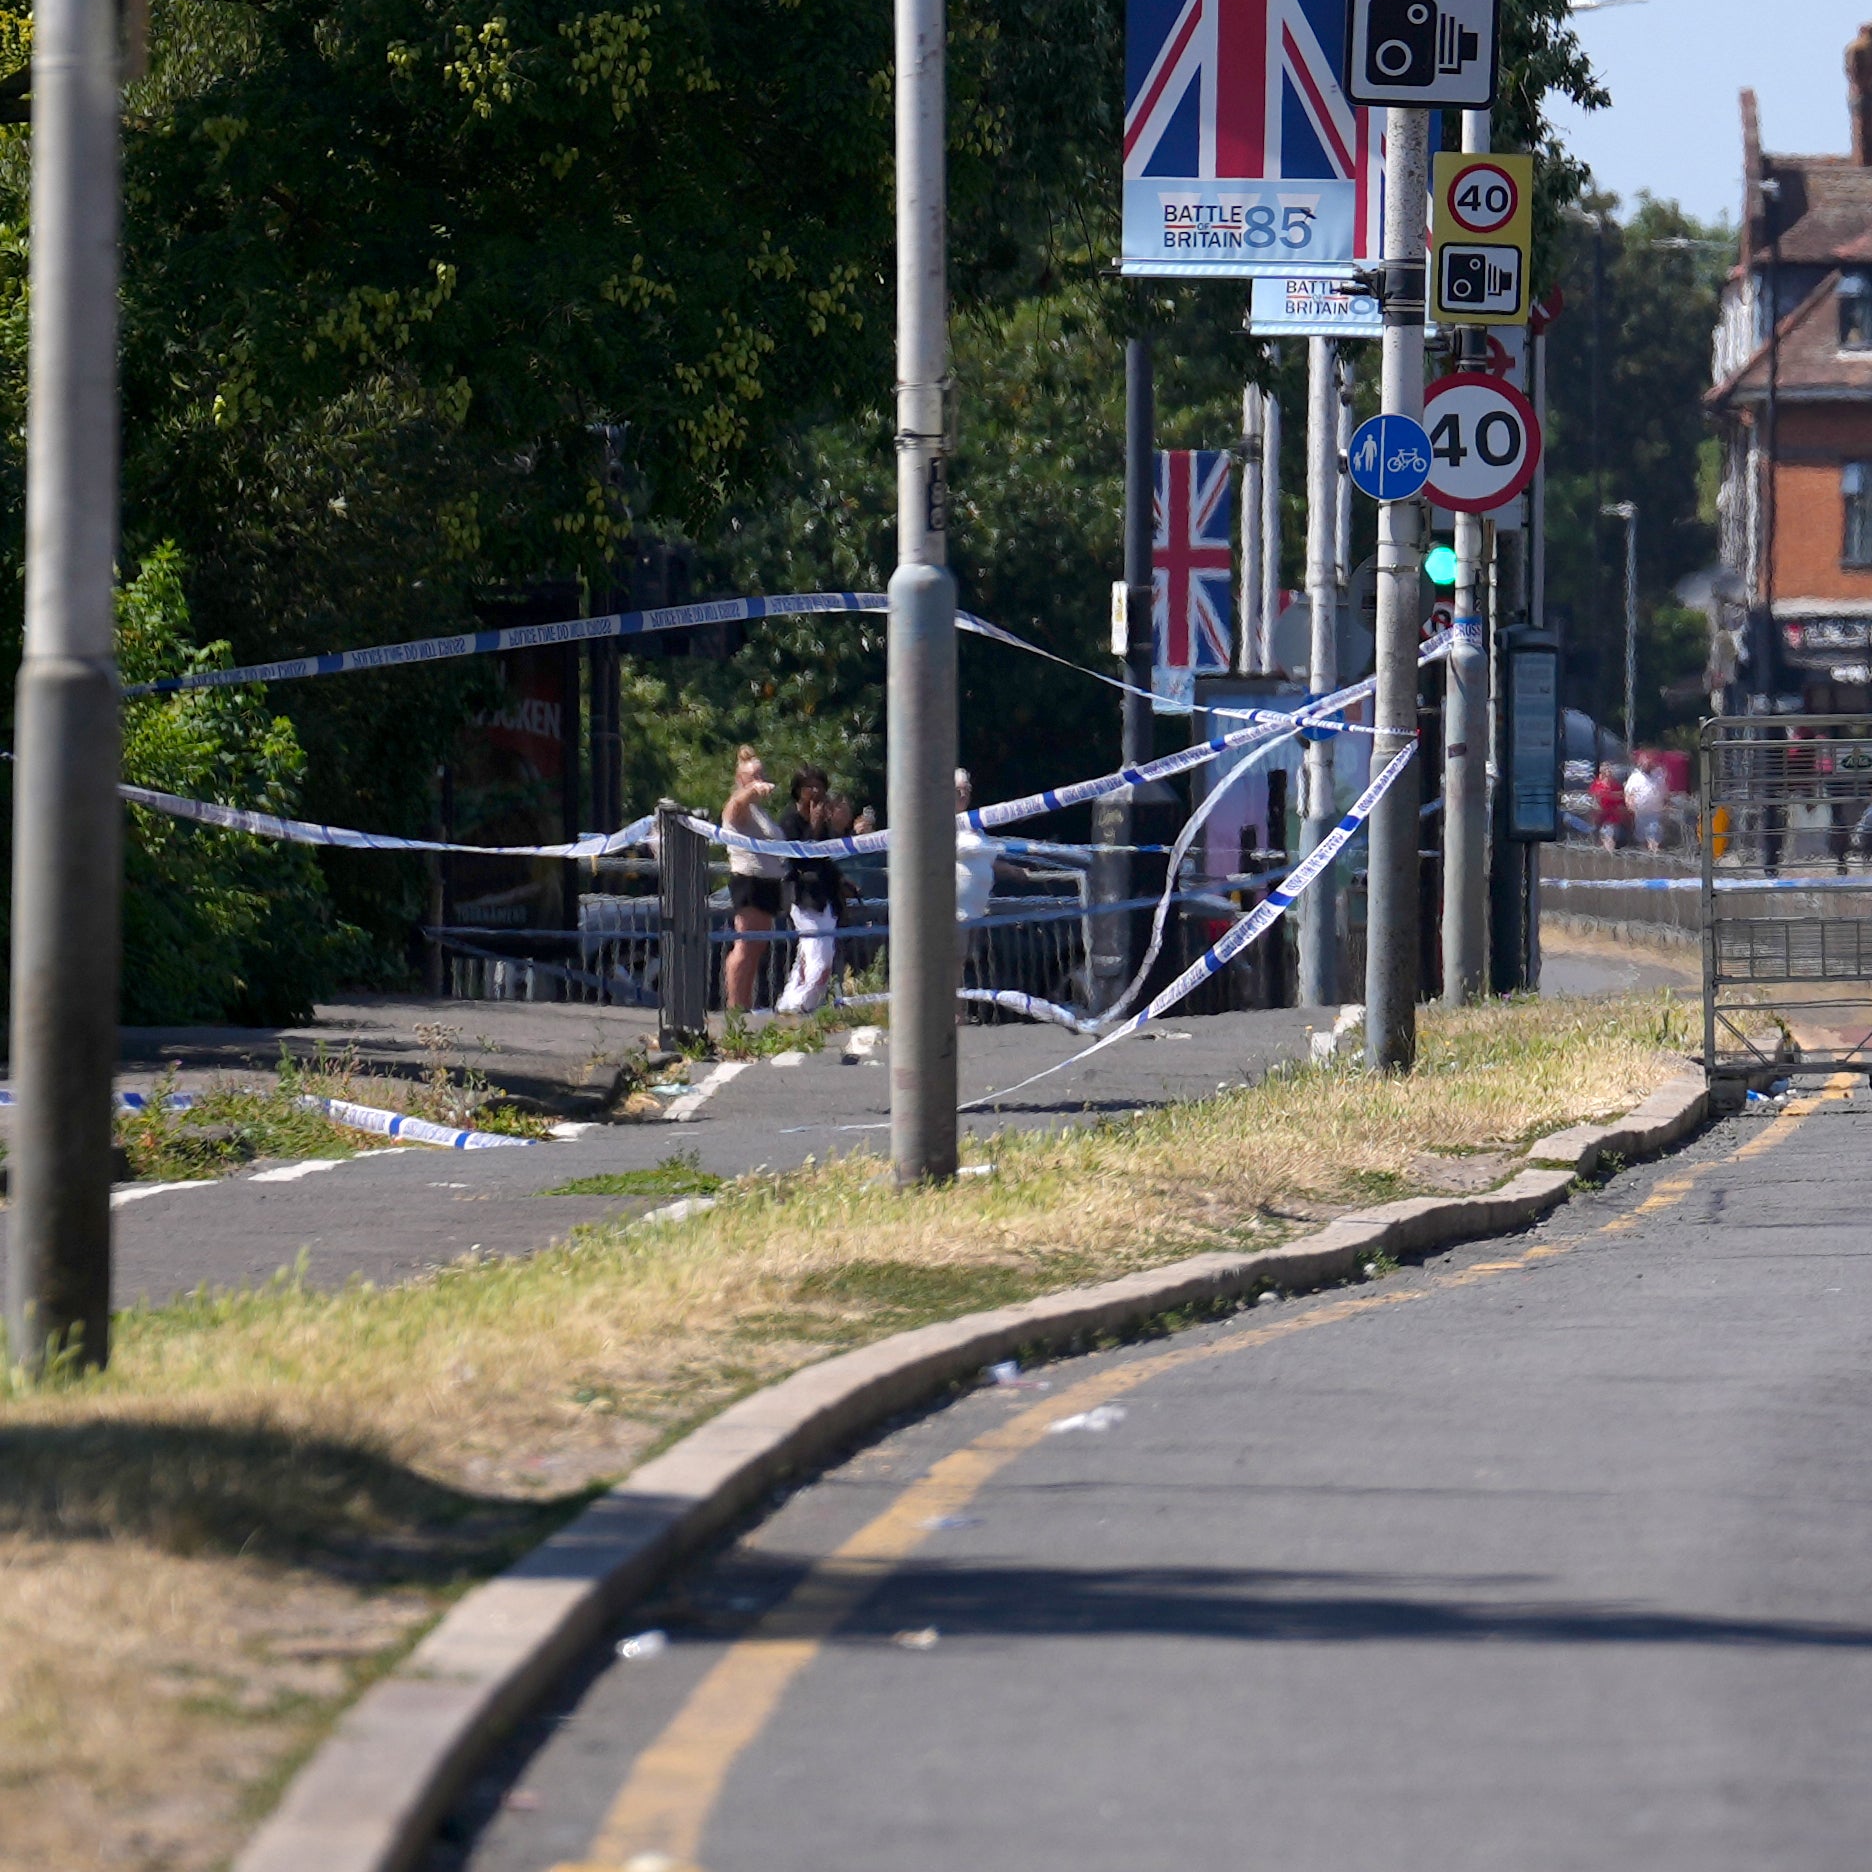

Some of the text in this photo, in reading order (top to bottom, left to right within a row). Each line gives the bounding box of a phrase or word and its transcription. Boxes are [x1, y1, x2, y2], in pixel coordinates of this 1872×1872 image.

[1457, 185, 1509, 213] 40
[1164, 205, 1313, 249] BATTLE 85
[1197, 222, 1209, 230] OF
[1164, 231, 1242, 248] BRITAIN
[1285, 301, 1348, 315] BRITAIN
[1430, 411, 1521, 467] 40
